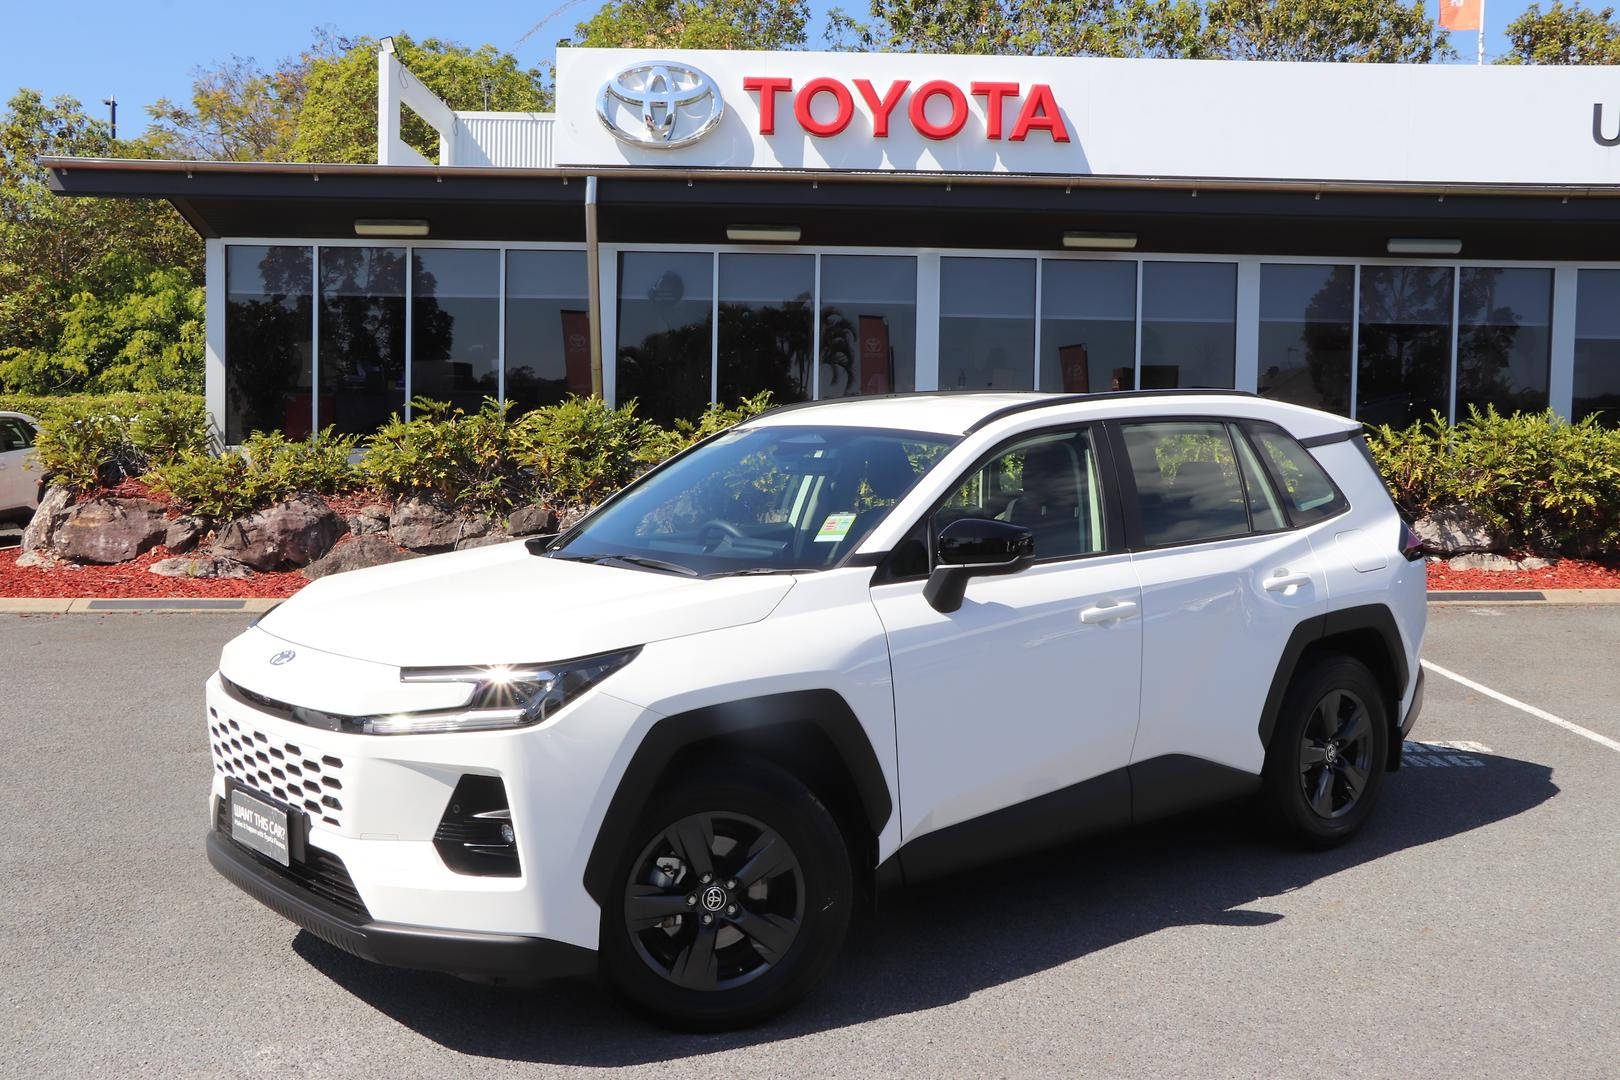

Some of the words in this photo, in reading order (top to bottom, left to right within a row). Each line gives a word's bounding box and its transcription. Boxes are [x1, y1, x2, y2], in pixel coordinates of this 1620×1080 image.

[743, 76, 1070, 143] TOYOTA
[233, 803, 254, 823] WANT
[254, 812, 269, 831] THIS
[269, 821, 286, 841] CAR?
